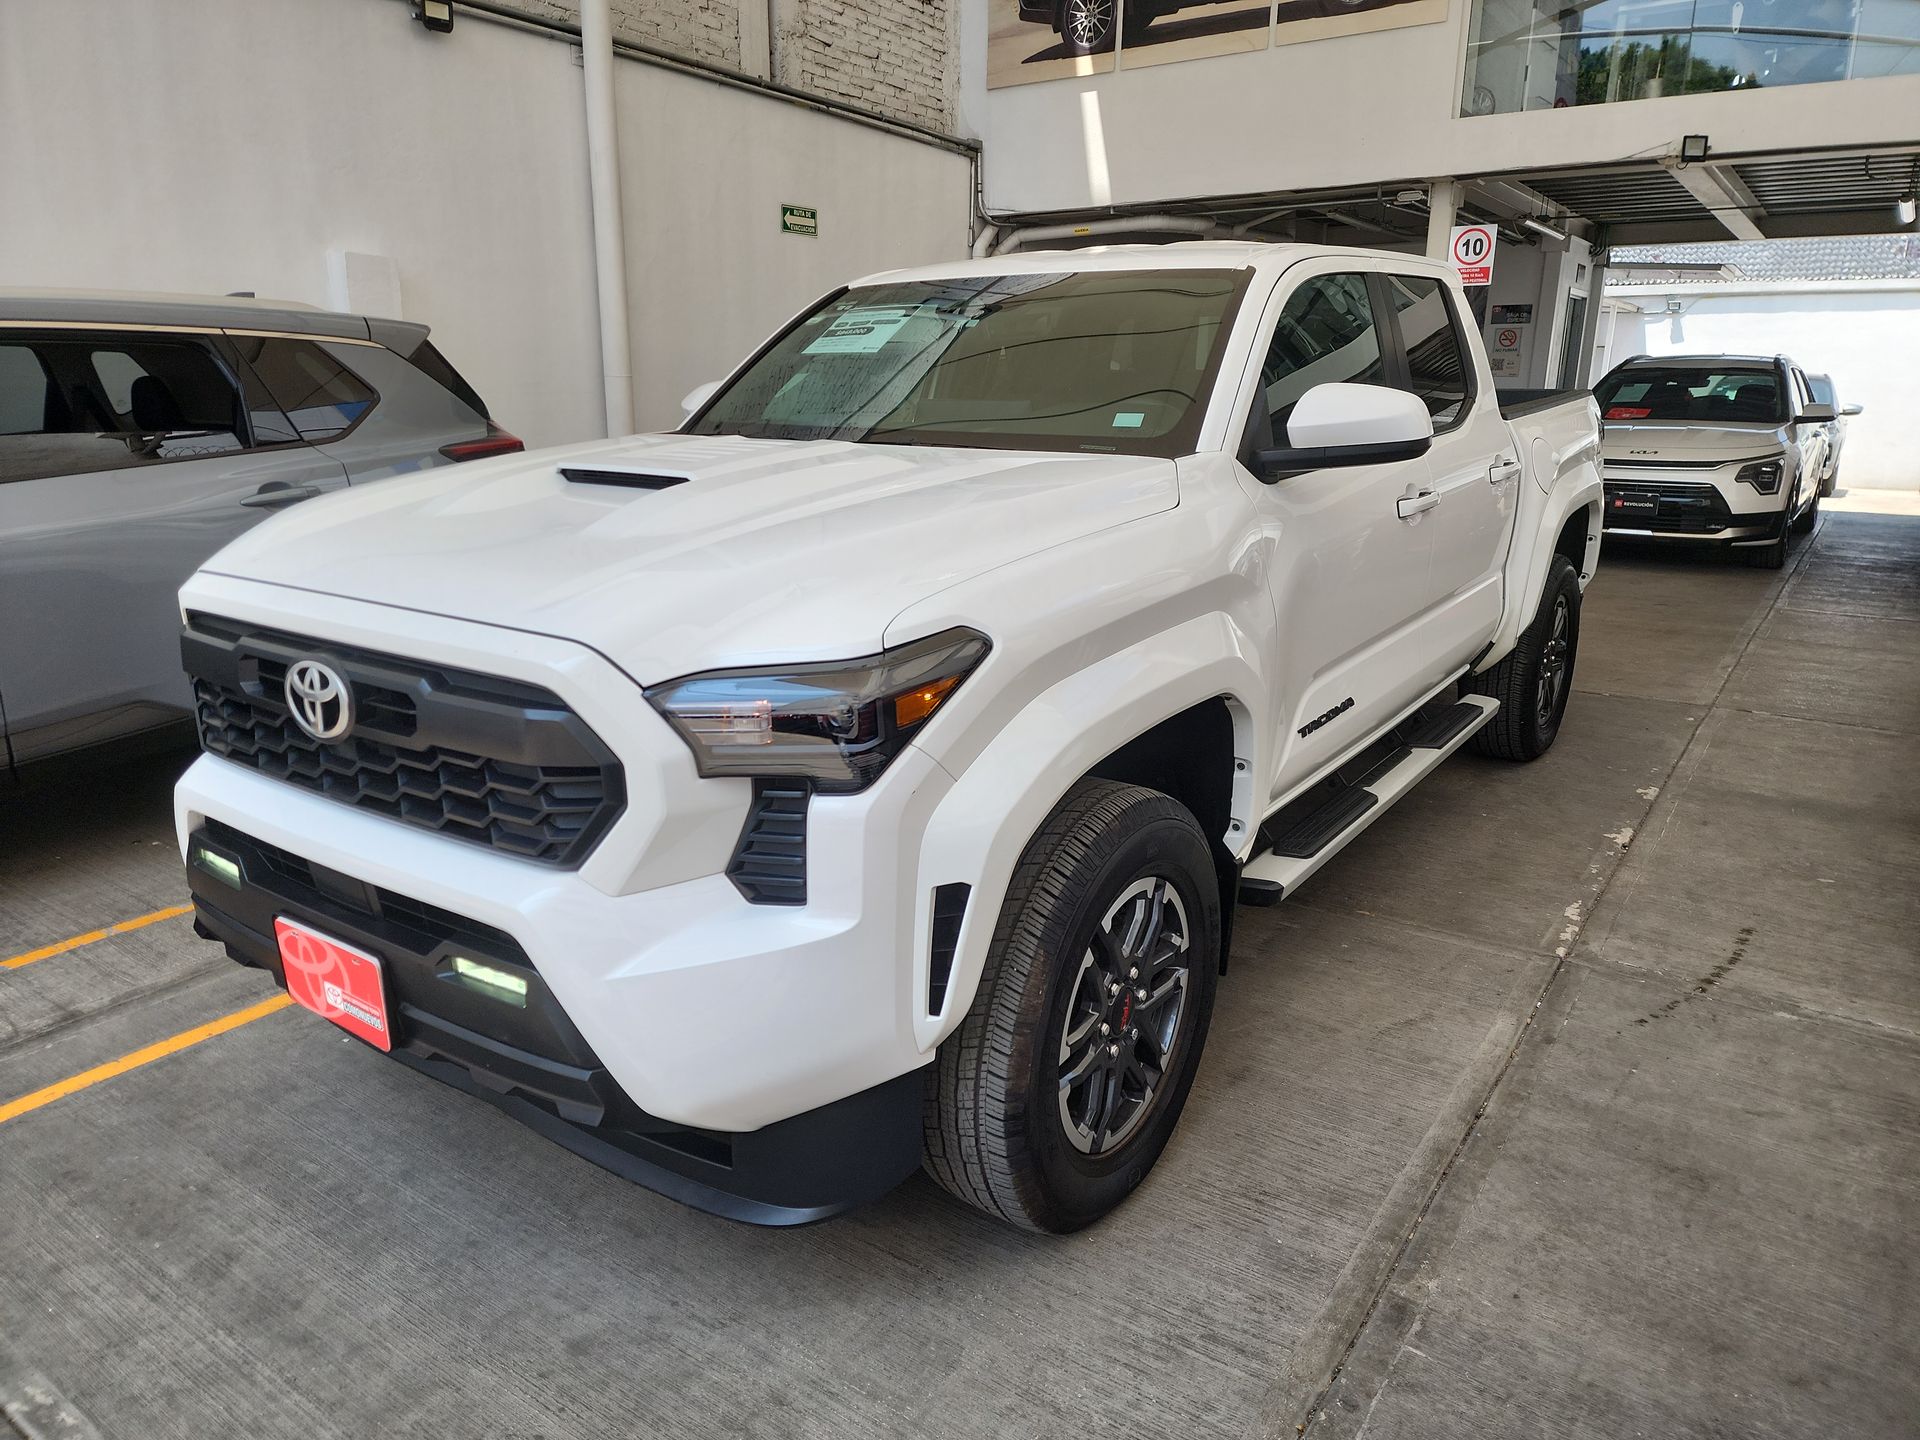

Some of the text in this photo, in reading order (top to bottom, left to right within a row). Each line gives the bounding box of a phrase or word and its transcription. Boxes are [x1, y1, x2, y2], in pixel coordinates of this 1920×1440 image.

[793, 209, 805, 217] RUTA
[1462, 238, 1484, 256] 10
[1297, 696, 1355, 738] TACOMA
